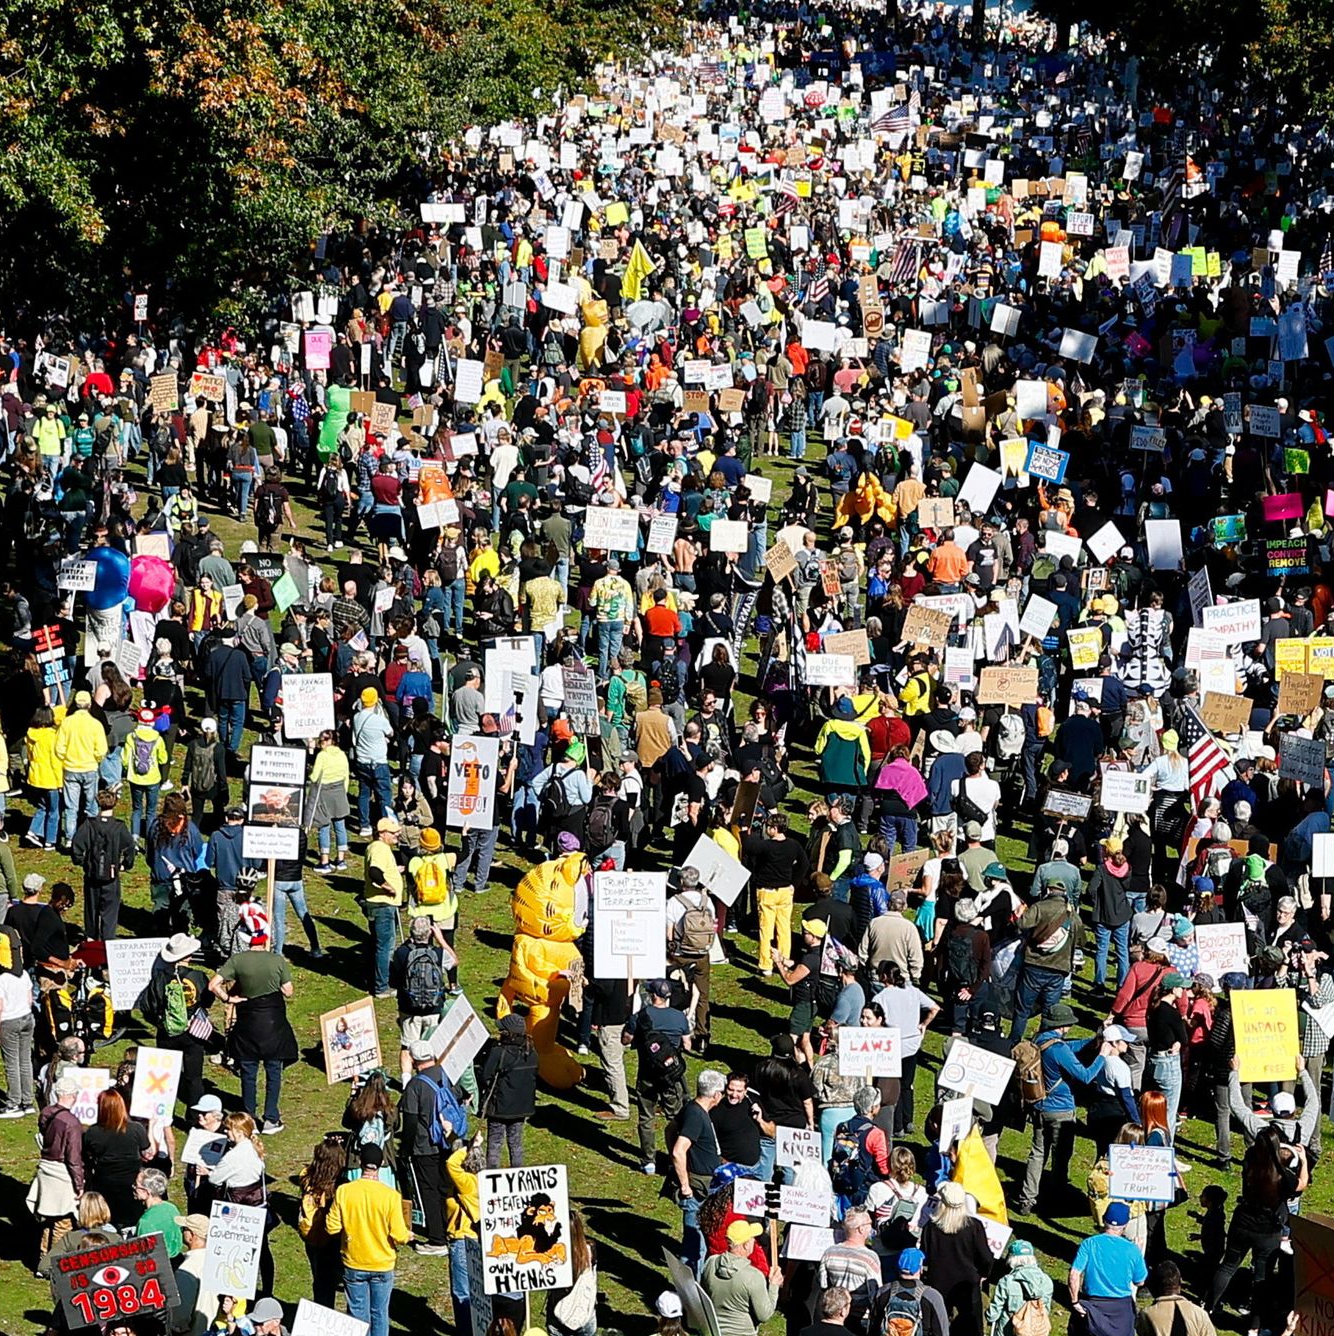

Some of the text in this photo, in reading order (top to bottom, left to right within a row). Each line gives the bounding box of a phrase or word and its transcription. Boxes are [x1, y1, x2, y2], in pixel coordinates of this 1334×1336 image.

[1266, 539, 1307, 550] IMPEACH
[1267, 549, 1307, 559] CONVICT
[259, 559, 272, 568] NO
[1269, 558, 1306, 568] REMOVE
[1266, 566, 1310, 577] IMPRISON
[1207, 602, 1257, 619] PRACTICE
[821, 656, 840, 666] DUE
[454, 762, 490, 780] VETO
[603, 877, 628, 888] TRUMP
[632, 878, 642, 888] IS
[602, 887, 649, 898] DOMESTIC
[1198, 934, 1244, 950] BOYCOTT
[1199, 948, 1238, 962] ORGAN
[1243, 1021, 1286, 1035] UNPAID
[850, 1039, 892, 1053] LAWS
[957, 1044, 1014, 1080] RESIST
[792, 1131, 812, 1142] NO
[485, 1167, 557, 1194] TYRANTS
[1132, 1171, 1155, 1183] NOT
[1123, 1182, 1157, 1194] TRUMP
[484, 1217, 498, 1232] BY
[58, 1235, 158, 1273] CENSORSHIP
[69, 1272, 90, 1290] IS
[495, 1268, 556, 1293] HYENAS
[71, 1278, 166, 1324] 1984
